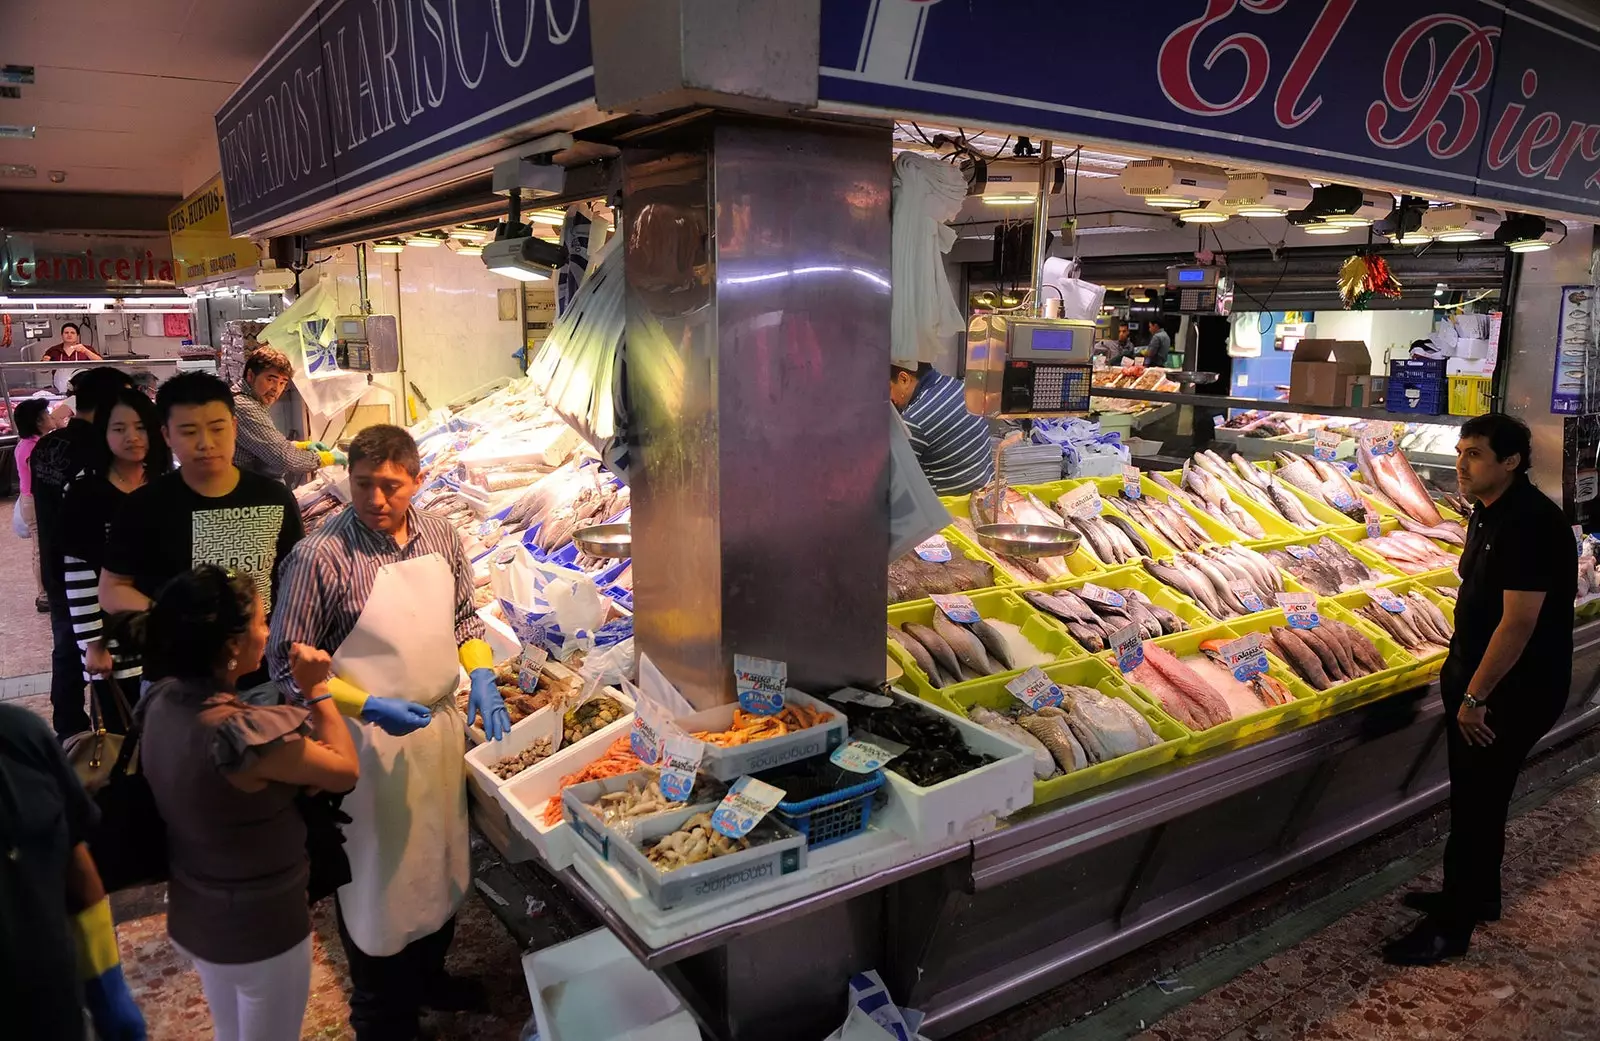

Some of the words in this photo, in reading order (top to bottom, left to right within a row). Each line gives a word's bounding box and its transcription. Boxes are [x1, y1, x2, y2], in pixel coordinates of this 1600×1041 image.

[221, 68, 316, 211] PESCADOS
[306, 65, 328, 169] Y
[187, 187, 220, 226] HUEVOS
[16, 249, 175, 282] carniceria
[223, 506, 259, 520] ROCK
[1287, 604, 1308, 612] Mero
[1231, 646, 1260, 664] Rodajas
[1026, 680, 1046, 698] Sepia
